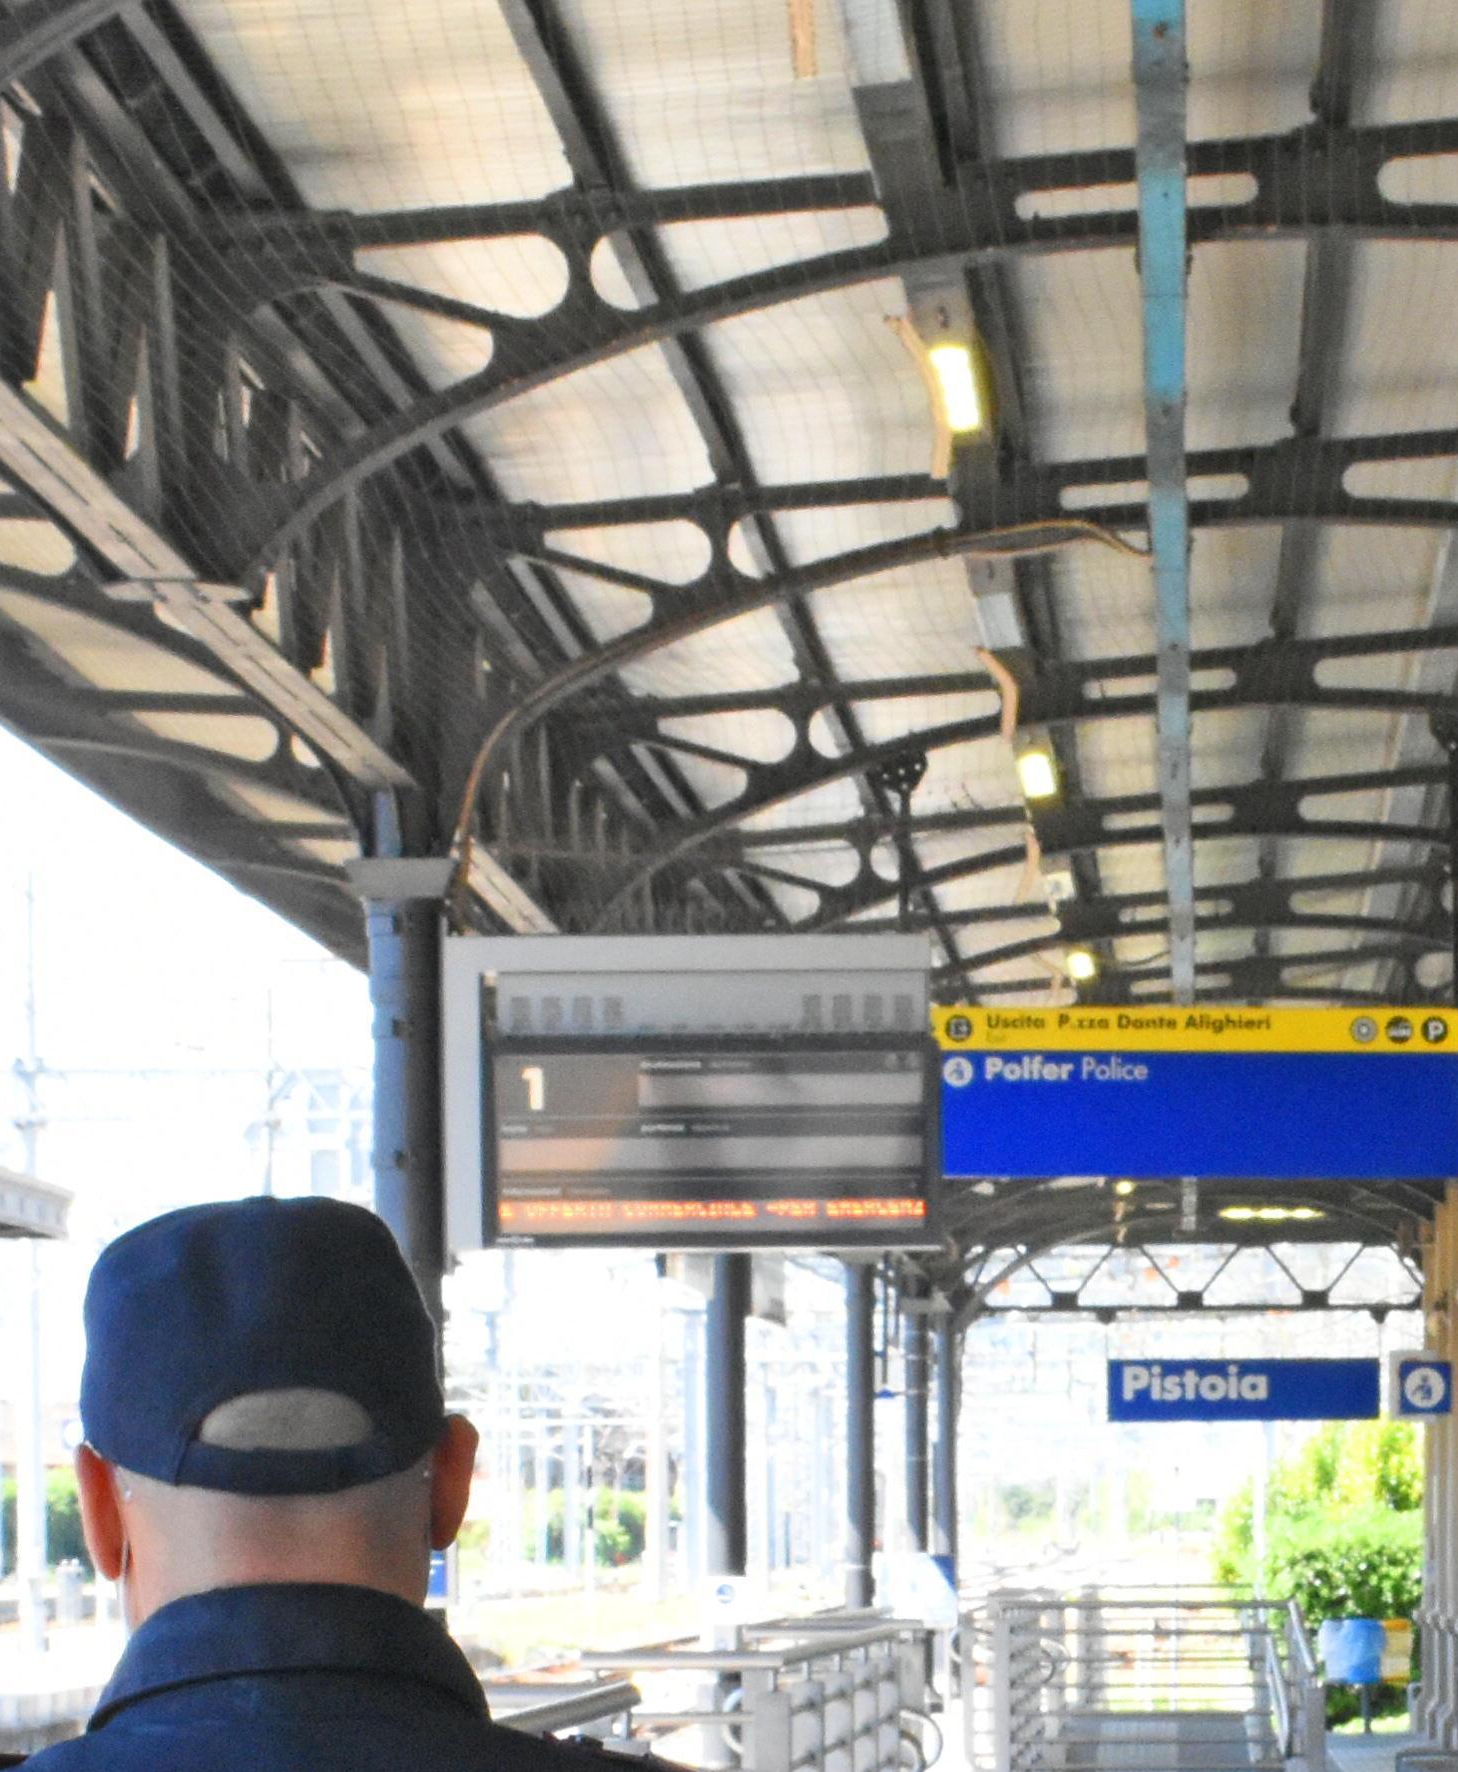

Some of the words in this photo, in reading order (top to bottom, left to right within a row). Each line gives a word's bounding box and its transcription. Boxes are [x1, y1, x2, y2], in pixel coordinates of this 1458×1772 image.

[986, 1012, 1046, 1030] Uscita
[1117, 1013, 1177, 1030] Dante
[1185, 1012, 1272, 1035] Alighieri
[984, 1056, 1074, 1081] Polfer
[1082, 1056, 1150, 1081] Police
[520, 1066, 544, 1111] 1
[1122, 1364, 1269, 1401] Pistoia
